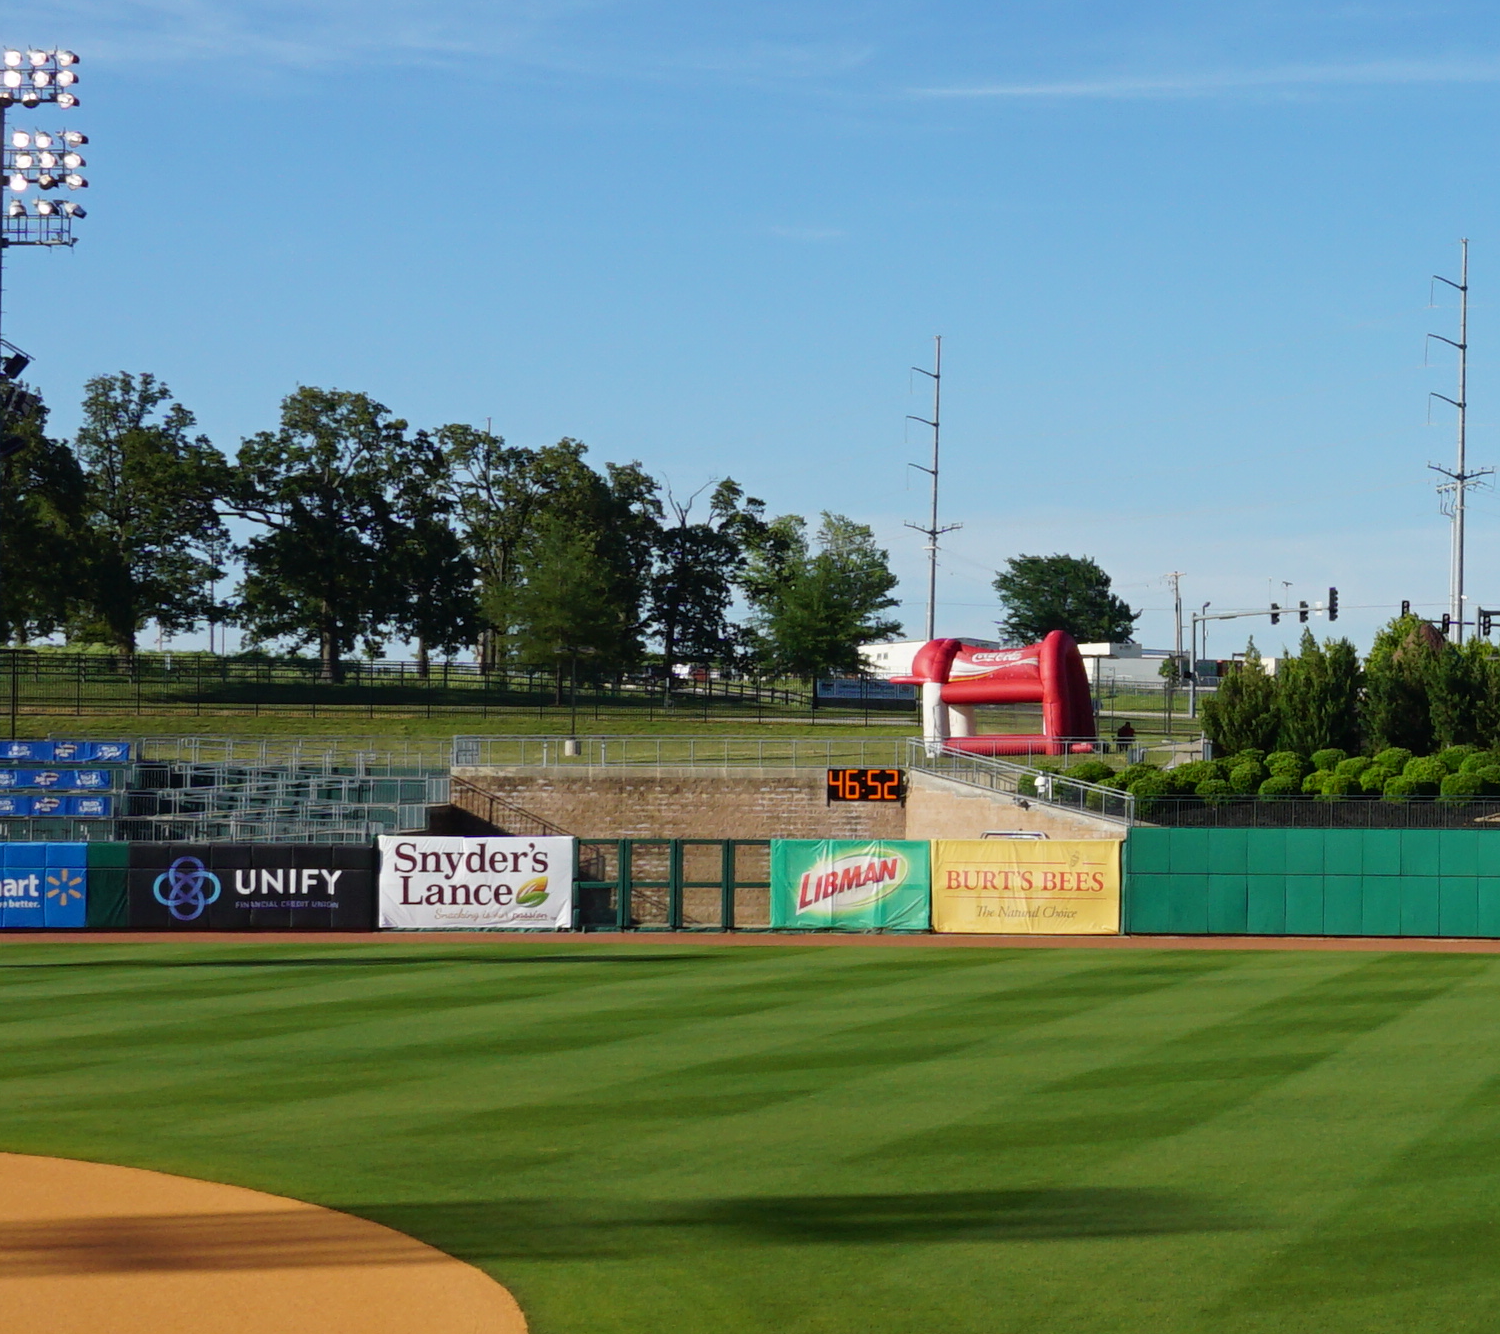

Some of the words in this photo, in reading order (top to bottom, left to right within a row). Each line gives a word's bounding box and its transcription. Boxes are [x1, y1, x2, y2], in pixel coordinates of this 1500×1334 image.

[828, 770, 899, 800] 46:52
[394, 842, 549, 880] Snyder's
[235, 869, 342, 896] UNIFY
[399, 876, 513, 906] Lance
[798, 857, 898, 910] LIBMAN
[944, 870, 1032, 892] BURT'S
[1042, 870, 1105, 892] BEES
[8, 899, 41, 909] better.
[311, 901, 339, 909] UNION
[976, 904, 995, 918] The
[998, 904, 1039, 919] Natural
[1042, 904, 1077, 919] Choice
